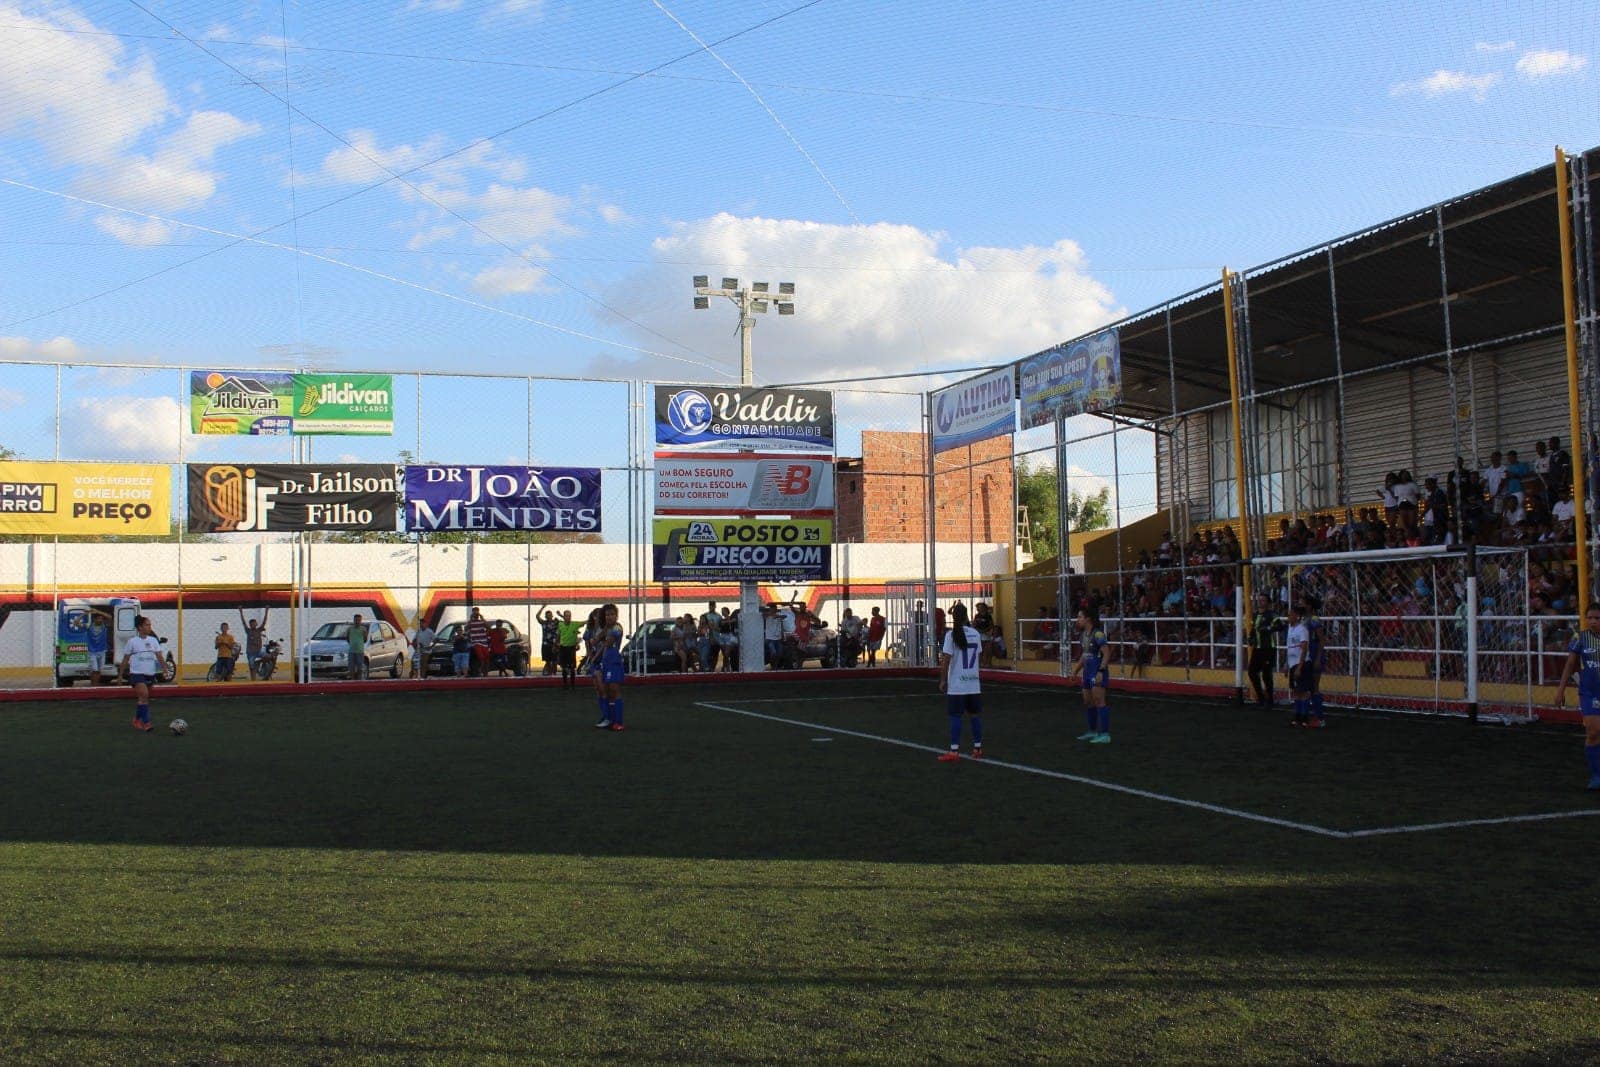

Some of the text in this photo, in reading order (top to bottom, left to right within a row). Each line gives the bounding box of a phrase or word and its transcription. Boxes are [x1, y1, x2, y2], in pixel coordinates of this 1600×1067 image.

[214, 391, 279, 409] Jildivan
[318, 383, 389, 404] Jildivan
[713, 392, 821, 422] Valdir
[712, 424, 821, 437] CONTABILIDADE
[672, 469, 693, 477] BOM
[695, 468, 734, 478] SEGURO
[0, 484, 42, 497] PIM
[280, 471, 395, 494] Dr Jailson
[426, 467, 582, 505] DR JOÃO
[709, 481, 748, 489] ESCOLHA
[73, 489, 152, 499] O MELHOR
[659, 491, 729, 499] DO SEU CORRETOR!
[0, 499, 42, 512] RRO
[73, 502, 152, 523] PREÇO
[305, 503, 373, 525] Filho
[410, 500, 597, 530] MENDES
[693, 523, 713, 535] 24
[722, 525, 800, 543] POSTO
[702, 546, 822, 567] PREÇO BOM
[962, 643, 978, 669] 17
